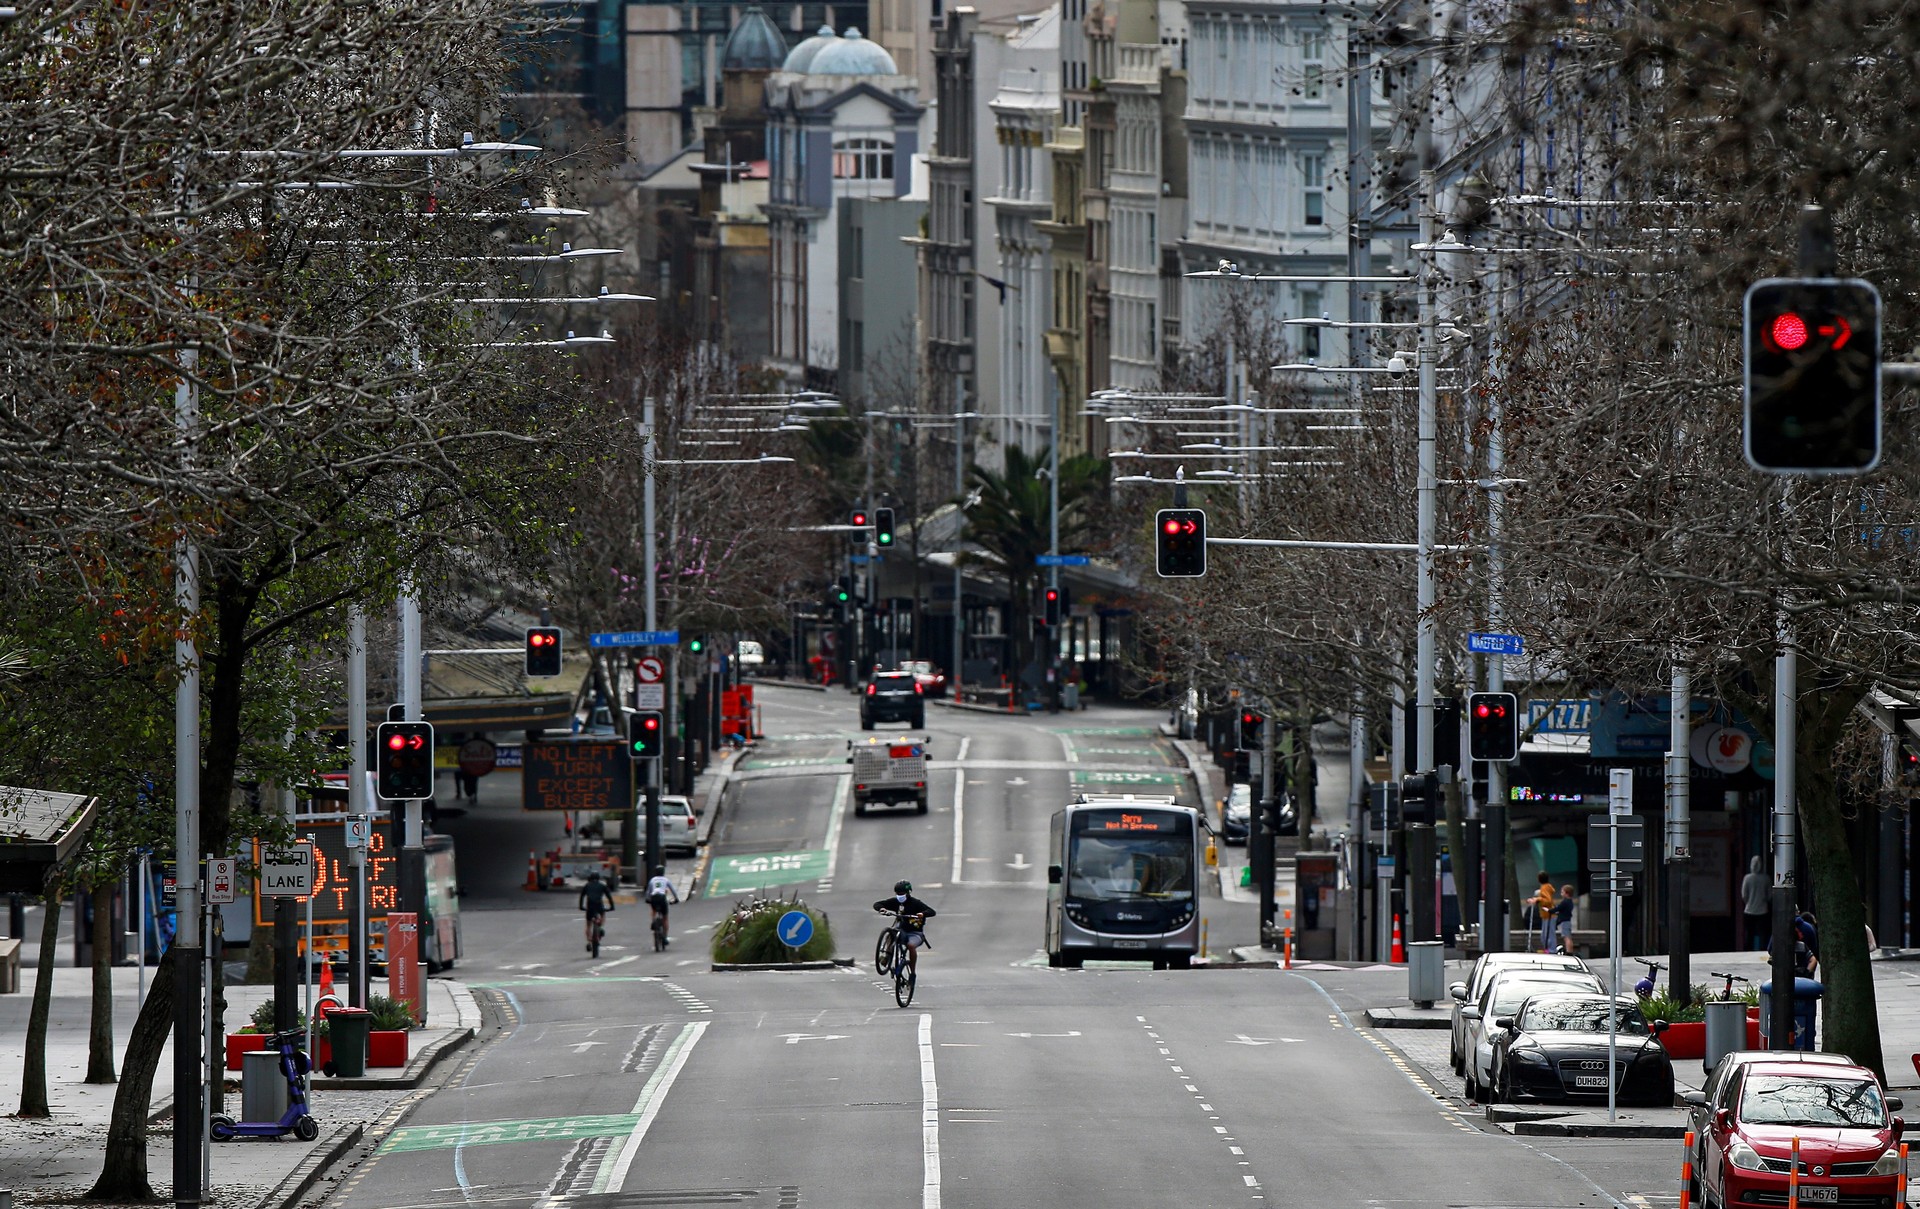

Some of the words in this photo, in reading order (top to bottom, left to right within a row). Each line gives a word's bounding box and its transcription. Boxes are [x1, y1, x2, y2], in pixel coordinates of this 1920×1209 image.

[612, 634, 655, 644] WELLESLEY
[533, 747, 559, 761] NO
[566, 746, 616, 761] LEFT
[553, 761, 602, 776] TURN
[538, 778, 613, 793] EXCEPT
[544, 793, 608, 808] BUSES
[1122, 814, 1142, 823] Sorry
[1106, 822, 1120, 830] Not
[1130, 822, 1158, 830] Service
[267, 876, 304, 887] LANE
[1577, 1077, 1608, 1086] DUH823
[1800, 1188, 1837, 1199] LLM676
